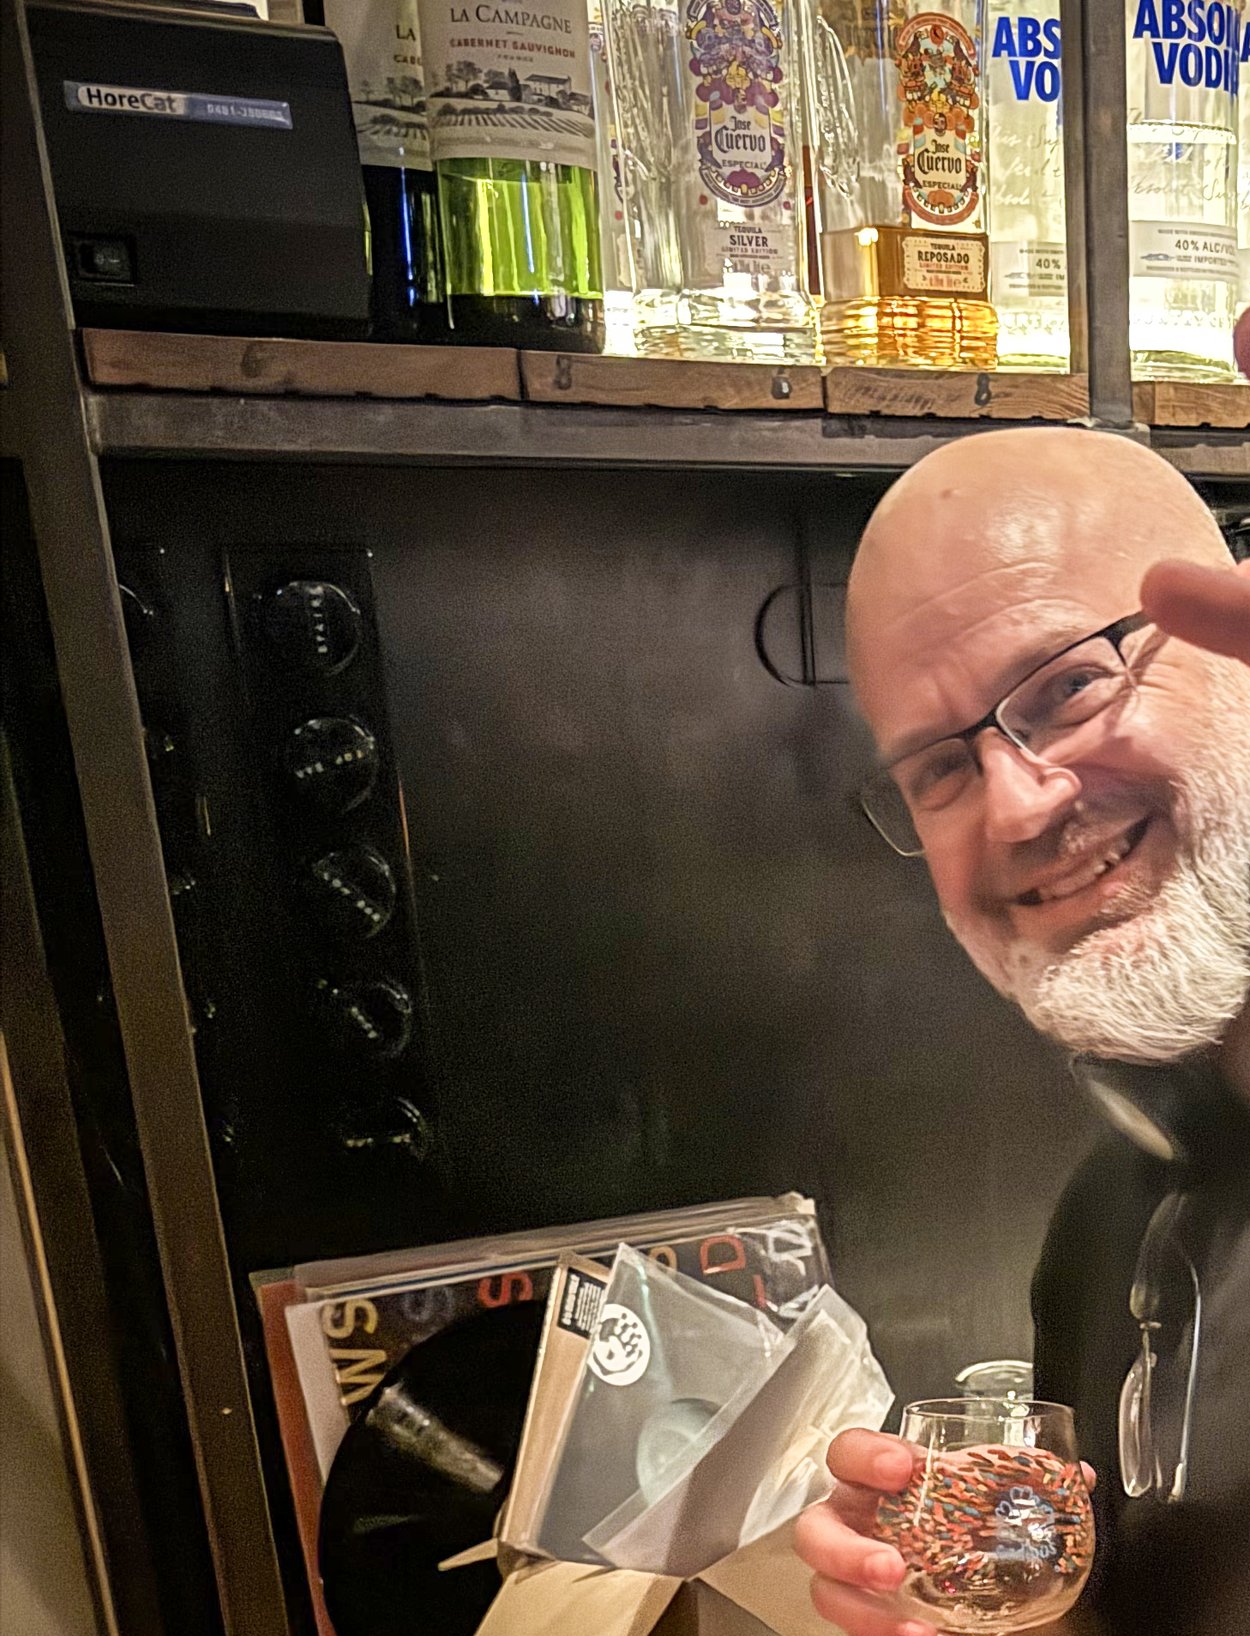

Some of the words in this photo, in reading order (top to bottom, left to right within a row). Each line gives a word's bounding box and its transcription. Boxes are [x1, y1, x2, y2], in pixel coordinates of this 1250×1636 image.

[451, 8, 469, 23] LA
[475, 4, 572, 34] CAMPAGNE
[86, 86, 177, 113] HoreCat
[731, 116, 751, 132] Jose
[715, 125, 766, 153] Cuervo
[931, 139, 950, 154] Jose
[722, 159, 765, 169] ESPECIAL
[917, 148, 962, 175] Cuervo
[922, 180, 962, 191] ESPECIAL
[734, 226, 762, 234] TEQUILA
[729, 234, 768, 247] SILVER
[930, 243, 956, 251] TEQUILA
[1175, 240, 1199, 251] 40%
[918, 251, 970, 264] REPOSADO
